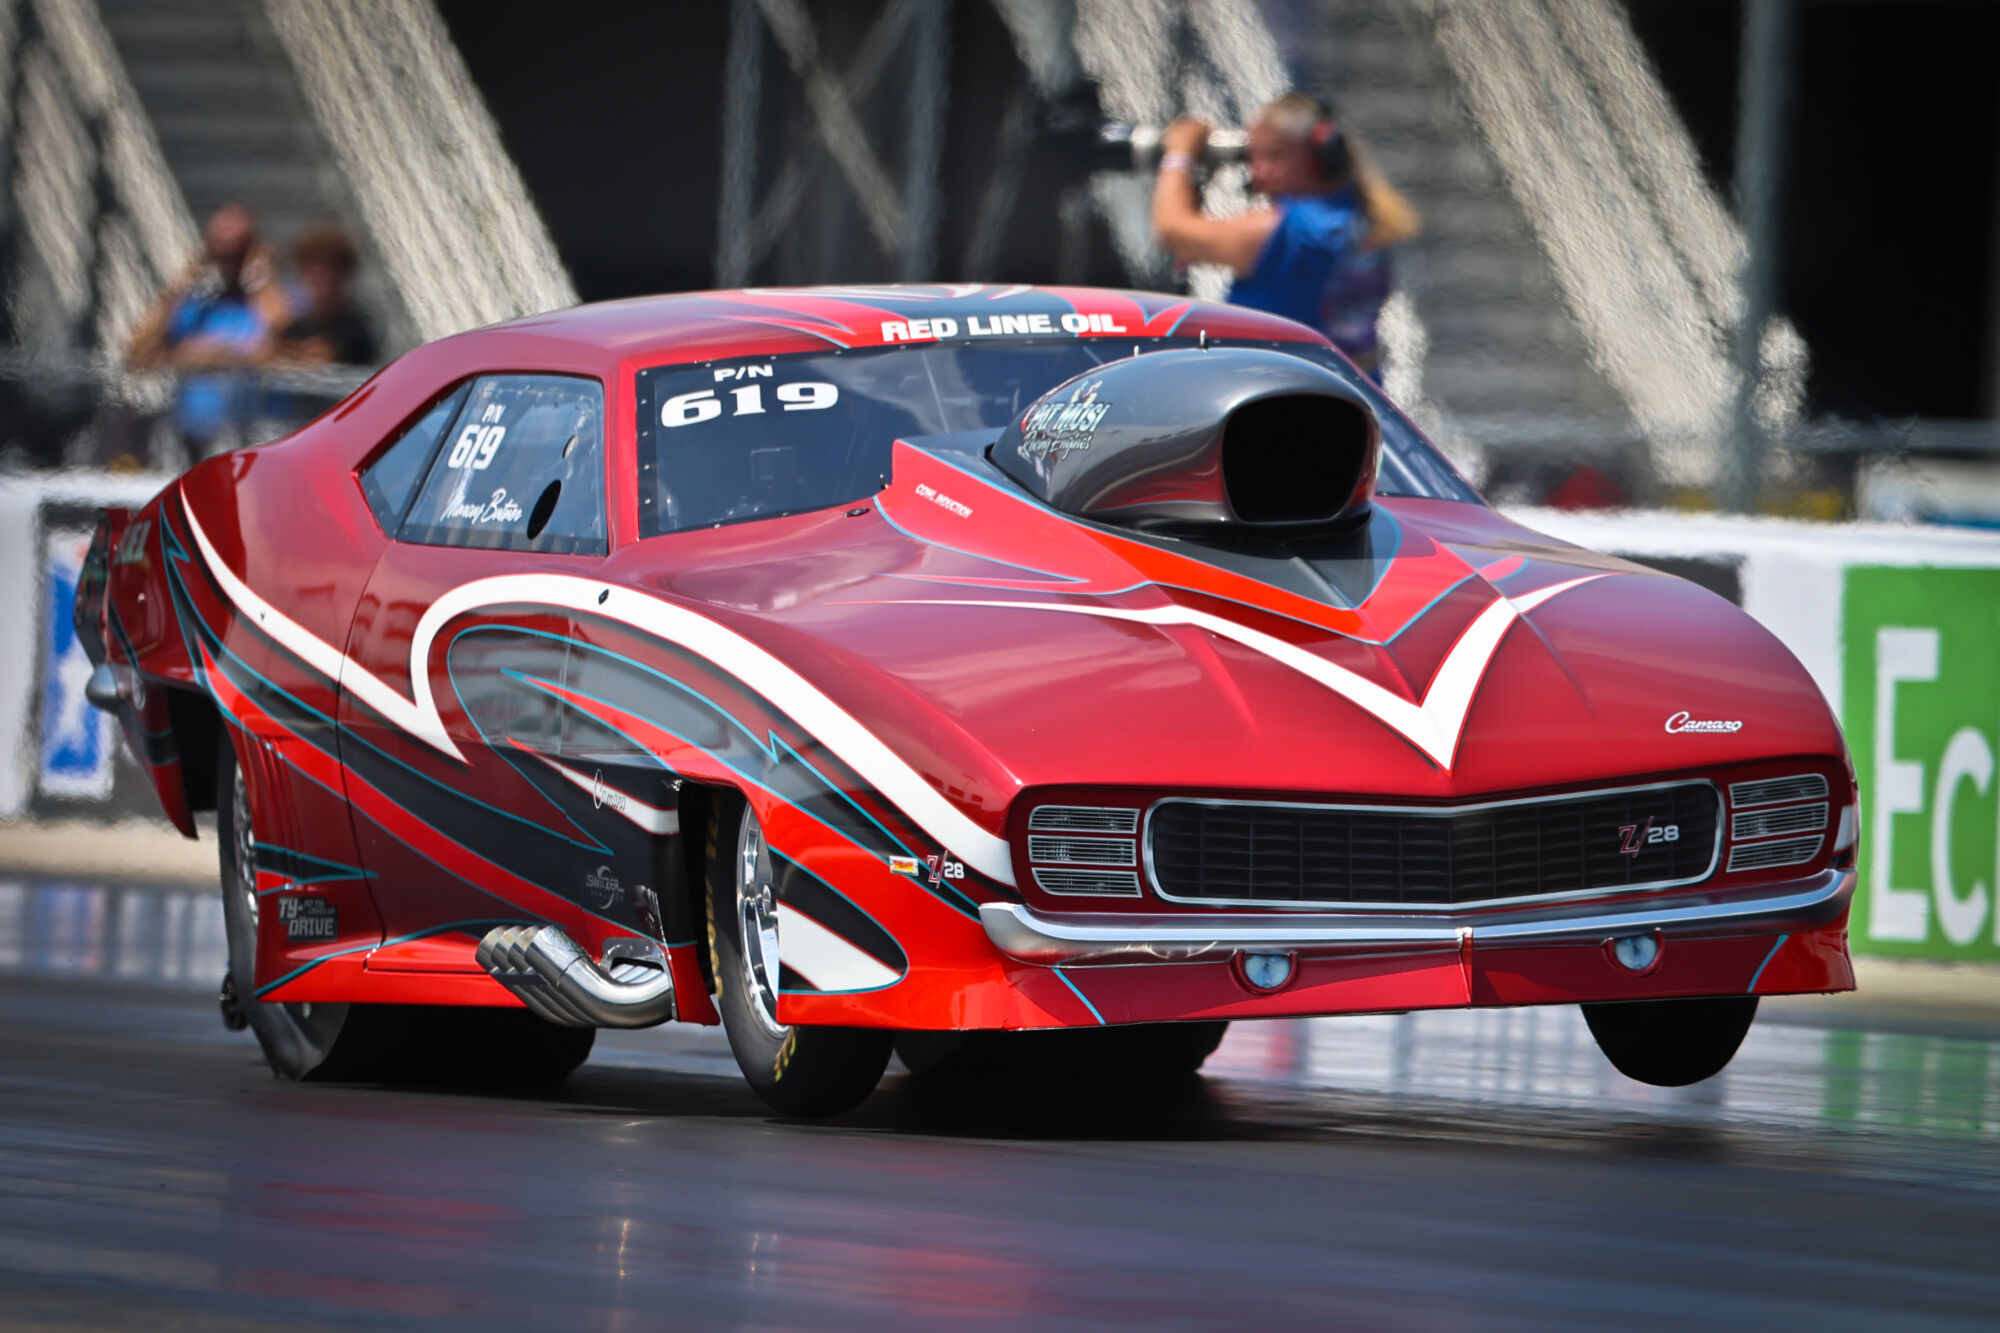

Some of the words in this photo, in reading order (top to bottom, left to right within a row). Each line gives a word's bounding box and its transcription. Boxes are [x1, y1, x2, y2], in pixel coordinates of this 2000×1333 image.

[881, 318, 958, 342] RED
[1061, 313, 1127, 333] OIL
[713, 364, 774, 382] P/N
[661, 382, 839, 428] 619
[1053, 403, 1111, 432] MUSI
[448, 424, 506, 470] 619
[1665, 711, 1744, 734] Camaro
[1618, 815, 1680, 858] Z/28
[926, 849, 965, 890] Z/28
[288, 917, 335, 937] DRIVE
